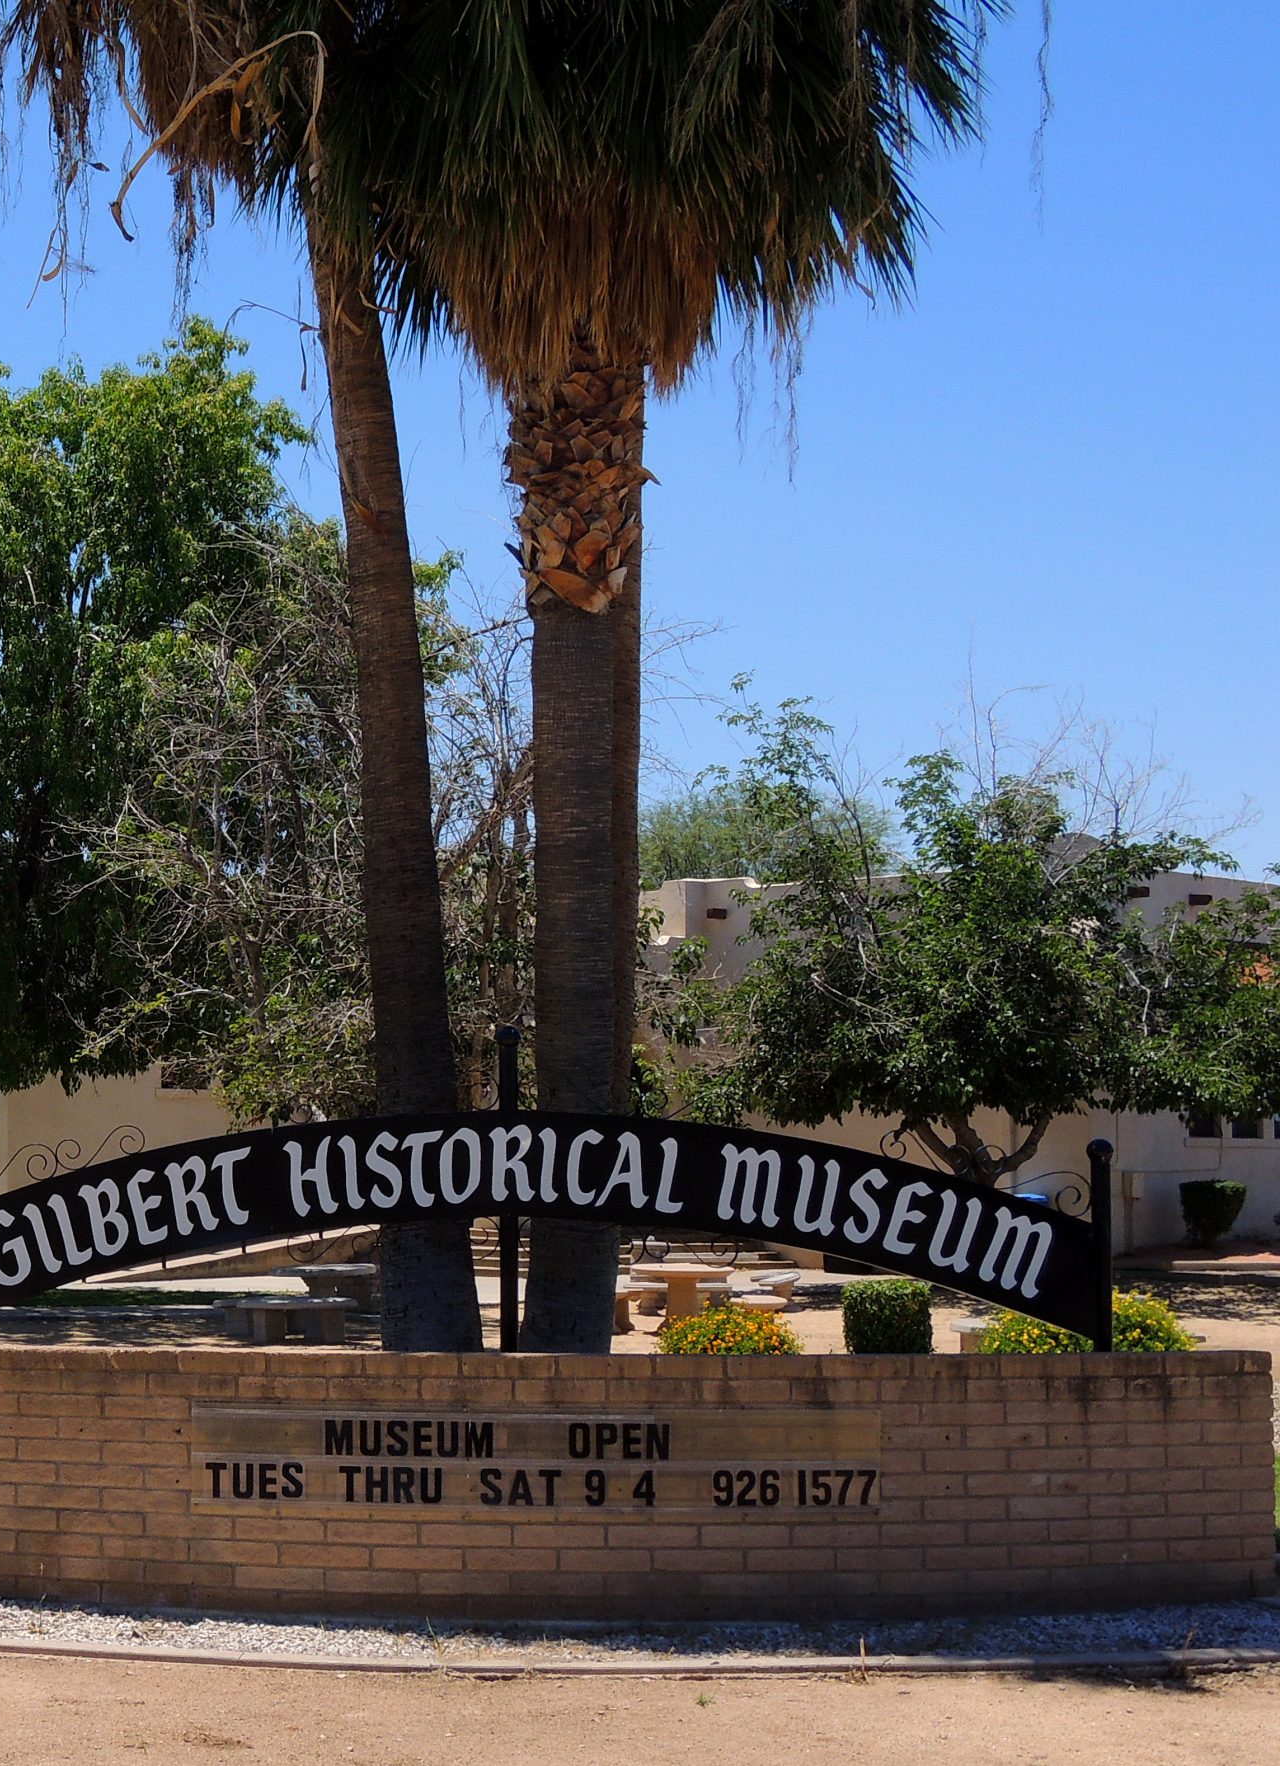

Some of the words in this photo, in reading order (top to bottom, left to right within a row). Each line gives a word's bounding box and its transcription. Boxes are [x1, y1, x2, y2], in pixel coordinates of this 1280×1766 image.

[283, 1124, 683, 1218] HISTORICAL
[717, 1143, 1054, 1299] MUSEUM
[324, 1419, 494, 1459] MUSEUM
[569, 1422, 670, 1461] OPEN
[205, 1461, 304, 1500] TUES
[339, 1465, 443, 1504] THRU
[480, 1468, 562, 1507] SAT
[584, 1469, 606, 1507] 9
[633, 1469, 656, 1507] 4
[713, 1469, 780, 1507] 926
[797, 1469, 877, 1507] 1577
